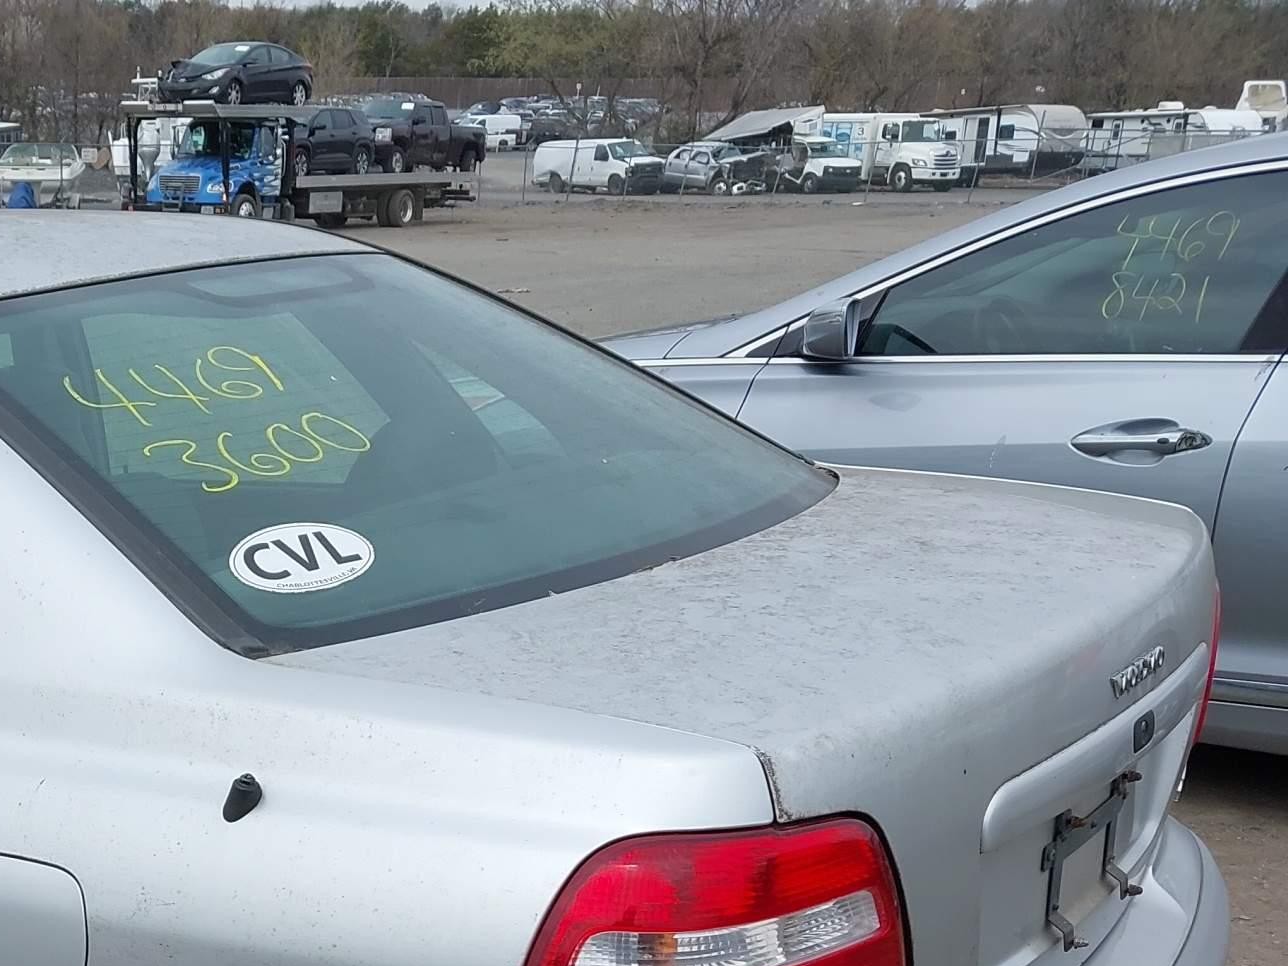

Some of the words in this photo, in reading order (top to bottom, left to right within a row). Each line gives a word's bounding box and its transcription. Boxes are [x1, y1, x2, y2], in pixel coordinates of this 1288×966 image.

[1116, 210, 1241, 271] 4469
[1101, 271, 1210, 324] 8421
[63, 345, 285, 426] 4469
[143, 411, 371, 493] 3600
[243, 530, 363, 581] CVL
[1109, 645, 1165, 700] VOLVO
